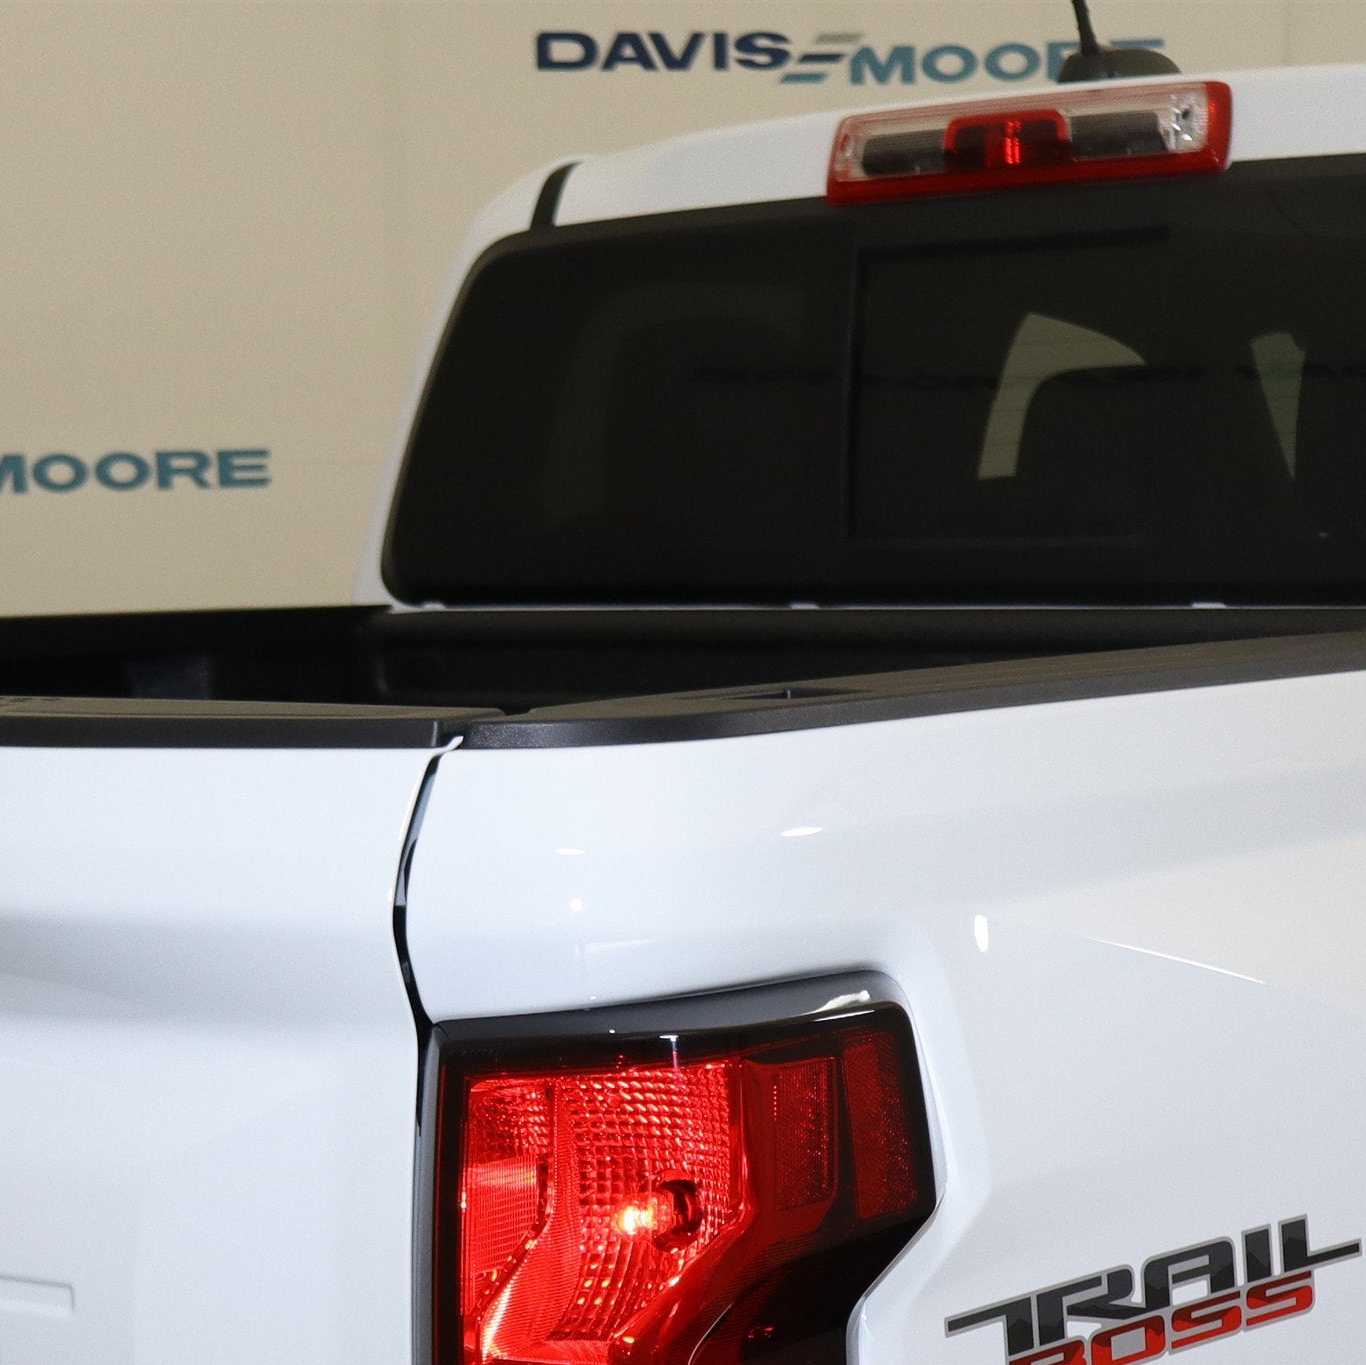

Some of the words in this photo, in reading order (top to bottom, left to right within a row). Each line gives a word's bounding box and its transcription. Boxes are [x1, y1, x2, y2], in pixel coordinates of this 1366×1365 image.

[535, 31, 791, 72] DAVIS
[848, 38, 1165, 85] MOO
[944, 1213, 1362, 1357] TRAIL
